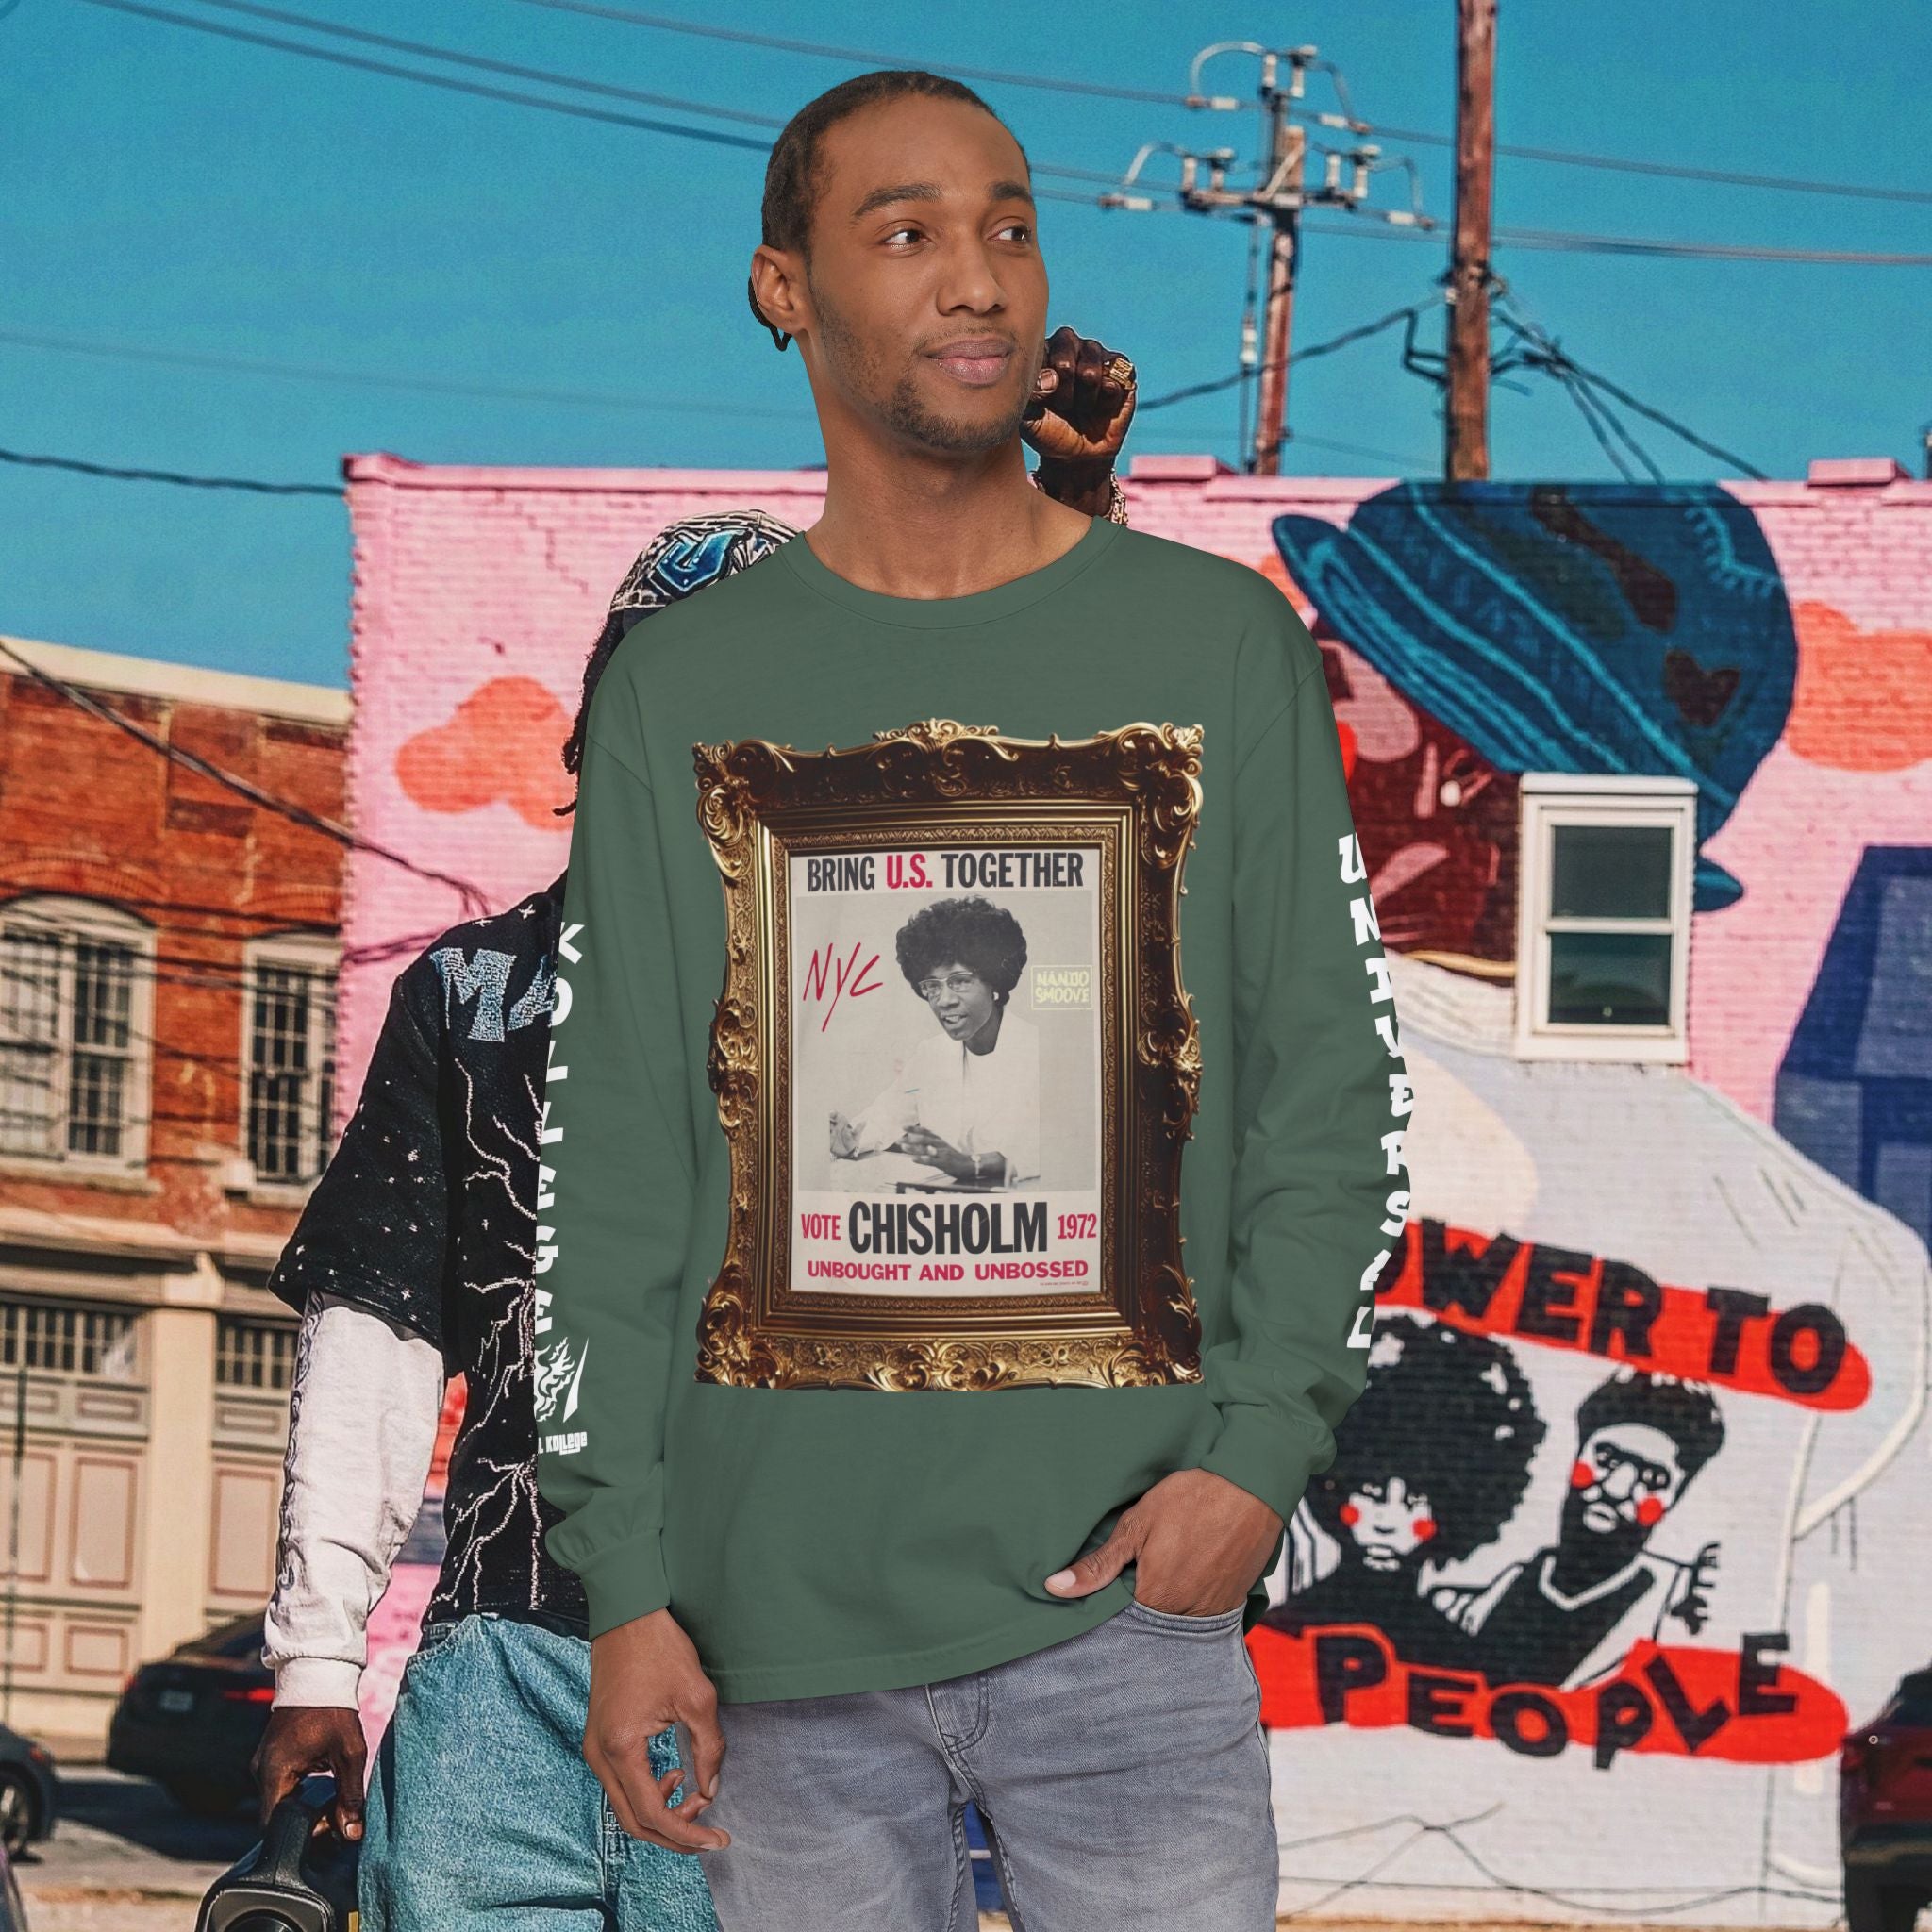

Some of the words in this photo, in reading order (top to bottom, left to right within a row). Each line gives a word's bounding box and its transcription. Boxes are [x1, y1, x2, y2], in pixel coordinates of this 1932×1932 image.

[808, 856, 875, 891] BRING
[887, 853, 933, 889] U.S.
[941, 852, 1084, 889] TOGETHER
[803, 942, 883, 1032] NYC
[1035, 987, 1089, 1003] SMOOVE
[1037, 971, 1089, 987] NANDO
[801, 1213, 841, 1241] VOTE
[849, 1201, 1048, 1255] CHISHOLM
[1057, 1213, 1097, 1240] 1972
[808, 1260, 911, 1281] UNBOUGHT
[918, 1264, 964, 1281] AND
[974, 1260, 1089, 1280] UNBOSSED
[1707, 1287, 1846, 1394] TO
[1315, 1632, 1797, 1770] PEOPLE
